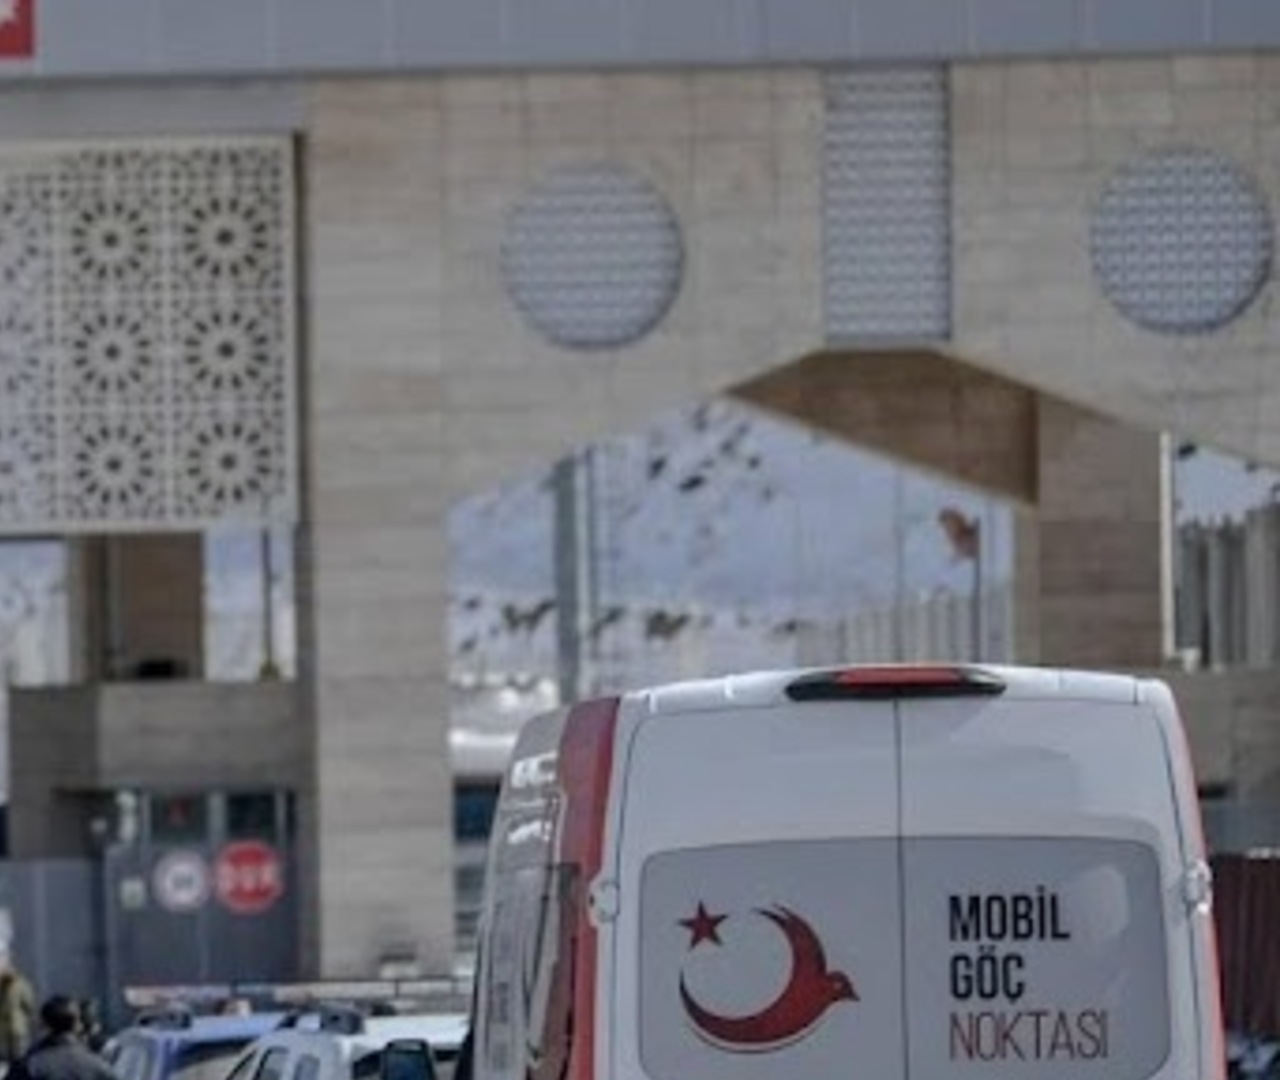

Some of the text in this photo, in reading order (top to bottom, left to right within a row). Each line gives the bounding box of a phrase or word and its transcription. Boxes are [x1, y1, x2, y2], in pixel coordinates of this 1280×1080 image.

[949, 885, 1071, 942] MOBİL
[950, 944, 1025, 1004] GÖÇ
[950, 1007, 1108, 1061] NOKTASI
